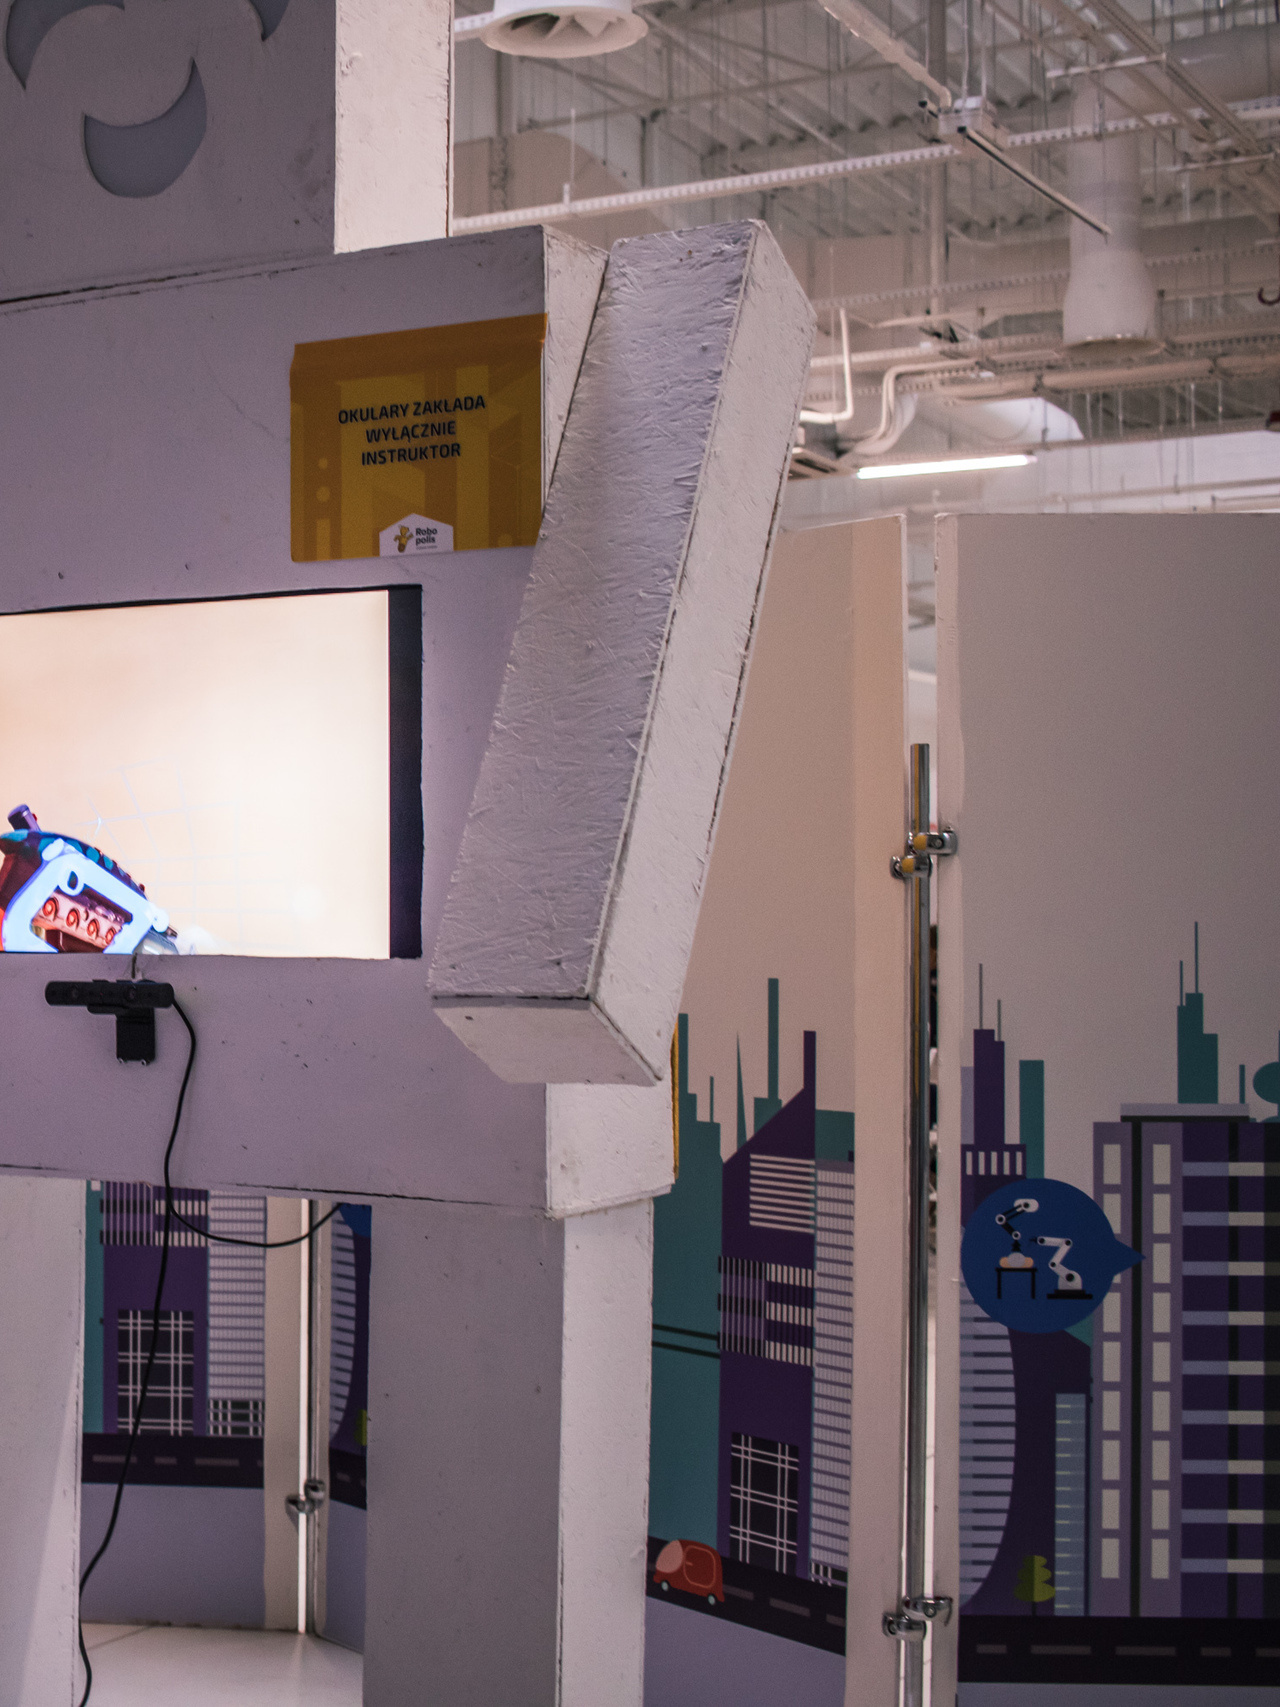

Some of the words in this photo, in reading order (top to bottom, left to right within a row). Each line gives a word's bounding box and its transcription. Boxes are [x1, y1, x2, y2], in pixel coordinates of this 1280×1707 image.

[338, 403, 410, 424] OKULARY
[412, 395, 486, 416] ZAKŁADA
[365, 421, 457, 444] WYŁĄCZNIE
[361, 443, 461, 466] INSTRUKTOR
[415, 527, 438, 536] Robo
[415, 536, 436, 546] polis
